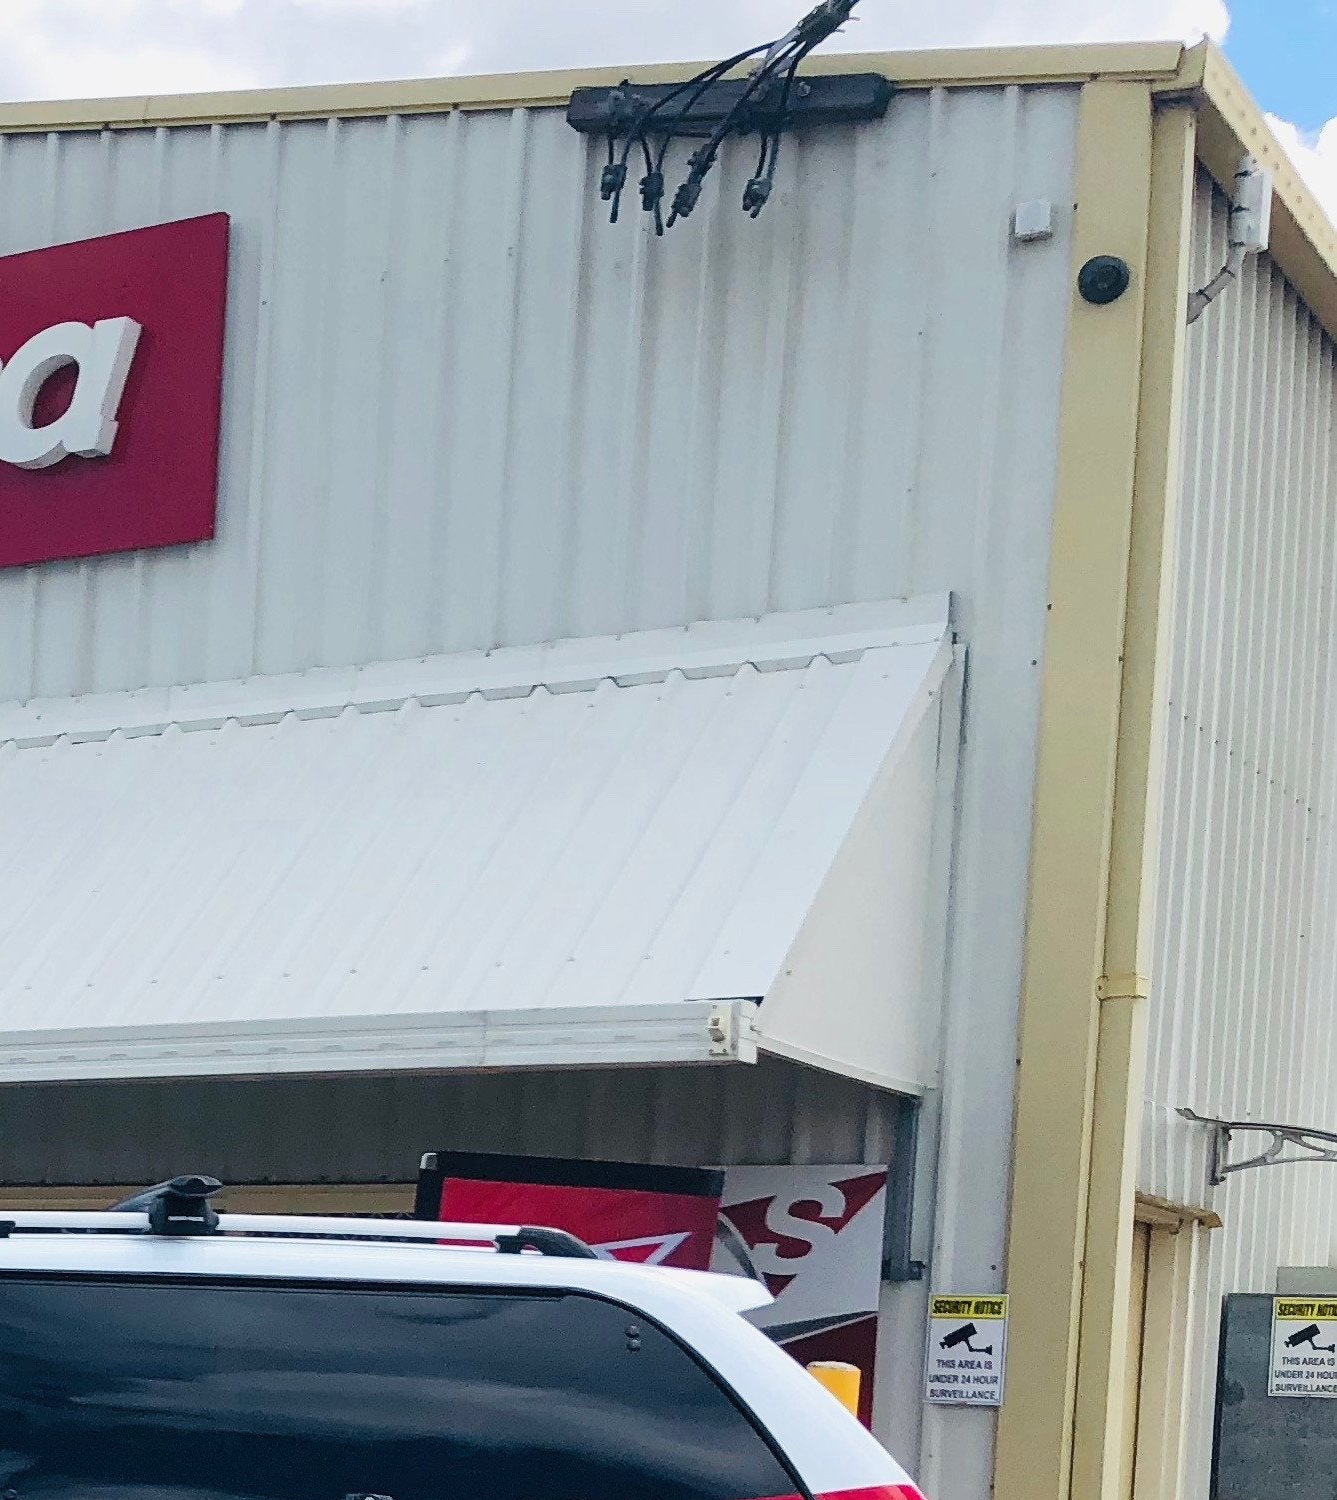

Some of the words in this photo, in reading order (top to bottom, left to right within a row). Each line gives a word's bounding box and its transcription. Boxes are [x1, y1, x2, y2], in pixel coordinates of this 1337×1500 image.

[936, 1359, 956, 1369] THIS
[958, 1360, 982, 1369] AREA
[984, 1360, 993, 1370] IS
[1282, 1357, 1300, 1366] THIS
[1302, 1357, 1325, 1366] AREA
[929, 1374, 959, 1384] UNDER
[961, 1375, 971, 1384] 24
[973, 1375, 999, 1385] HOUR
[1274, 1370, 1304, 1379] UNDER
[929, 1388, 996, 1399] SURVEILLANCE
